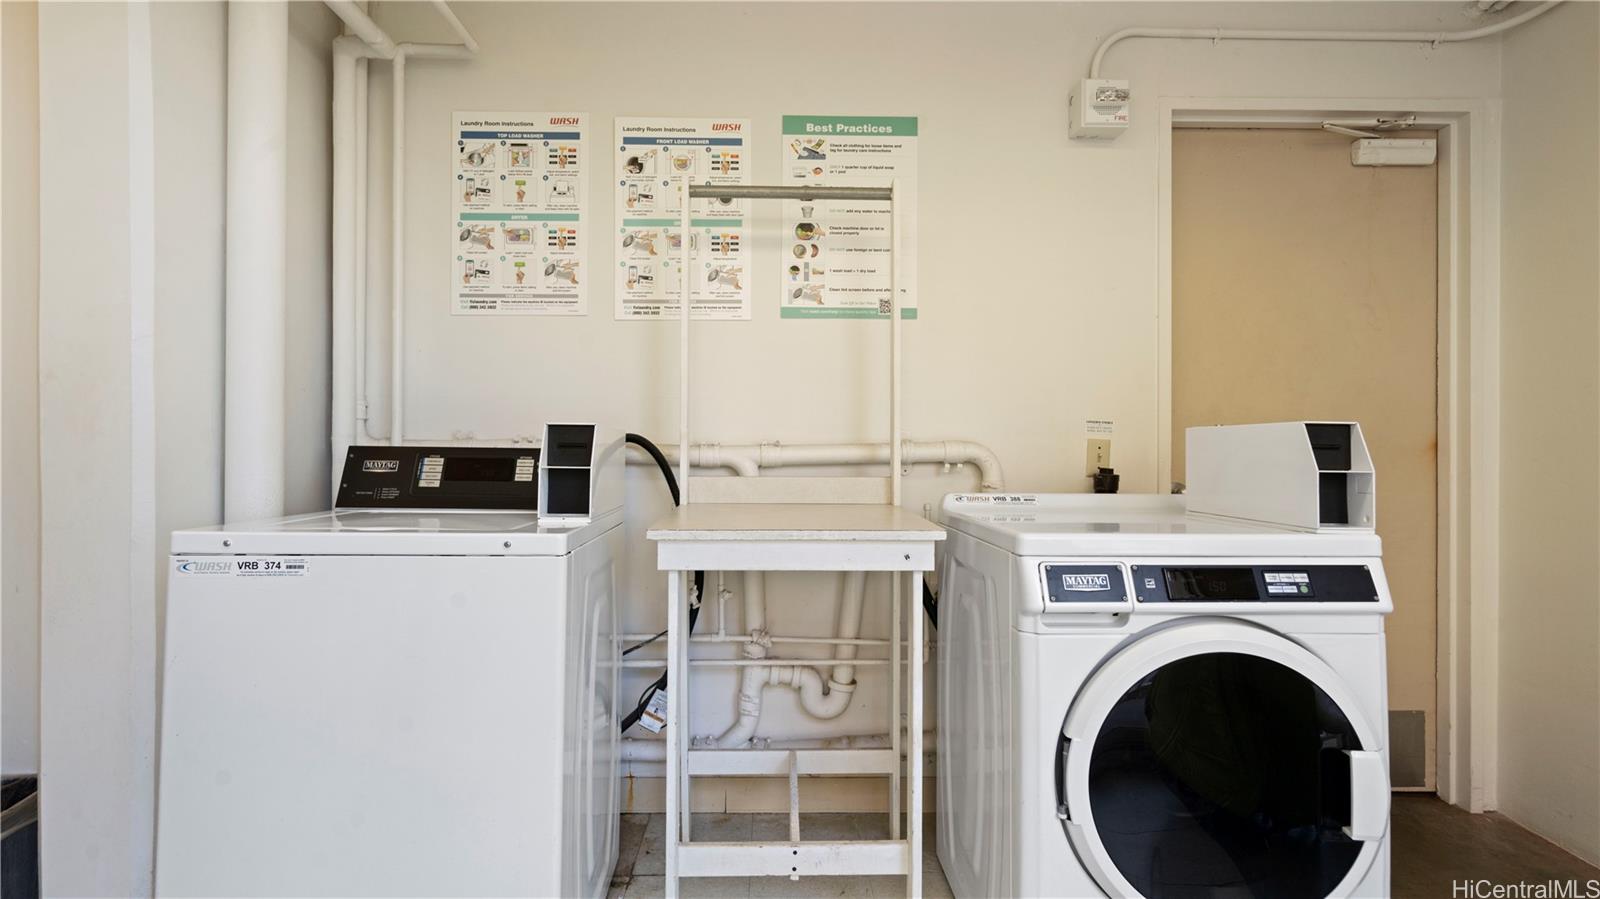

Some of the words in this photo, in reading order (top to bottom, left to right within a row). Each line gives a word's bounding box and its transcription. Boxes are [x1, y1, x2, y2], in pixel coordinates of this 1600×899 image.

[550, 117, 579, 125] WASH
[806, 123, 832, 132] Best
[836, 124, 892, 133] Practices
[194, 562, 232, 571] WASH
[1066, 576, 1106, 585] MAYTAG
